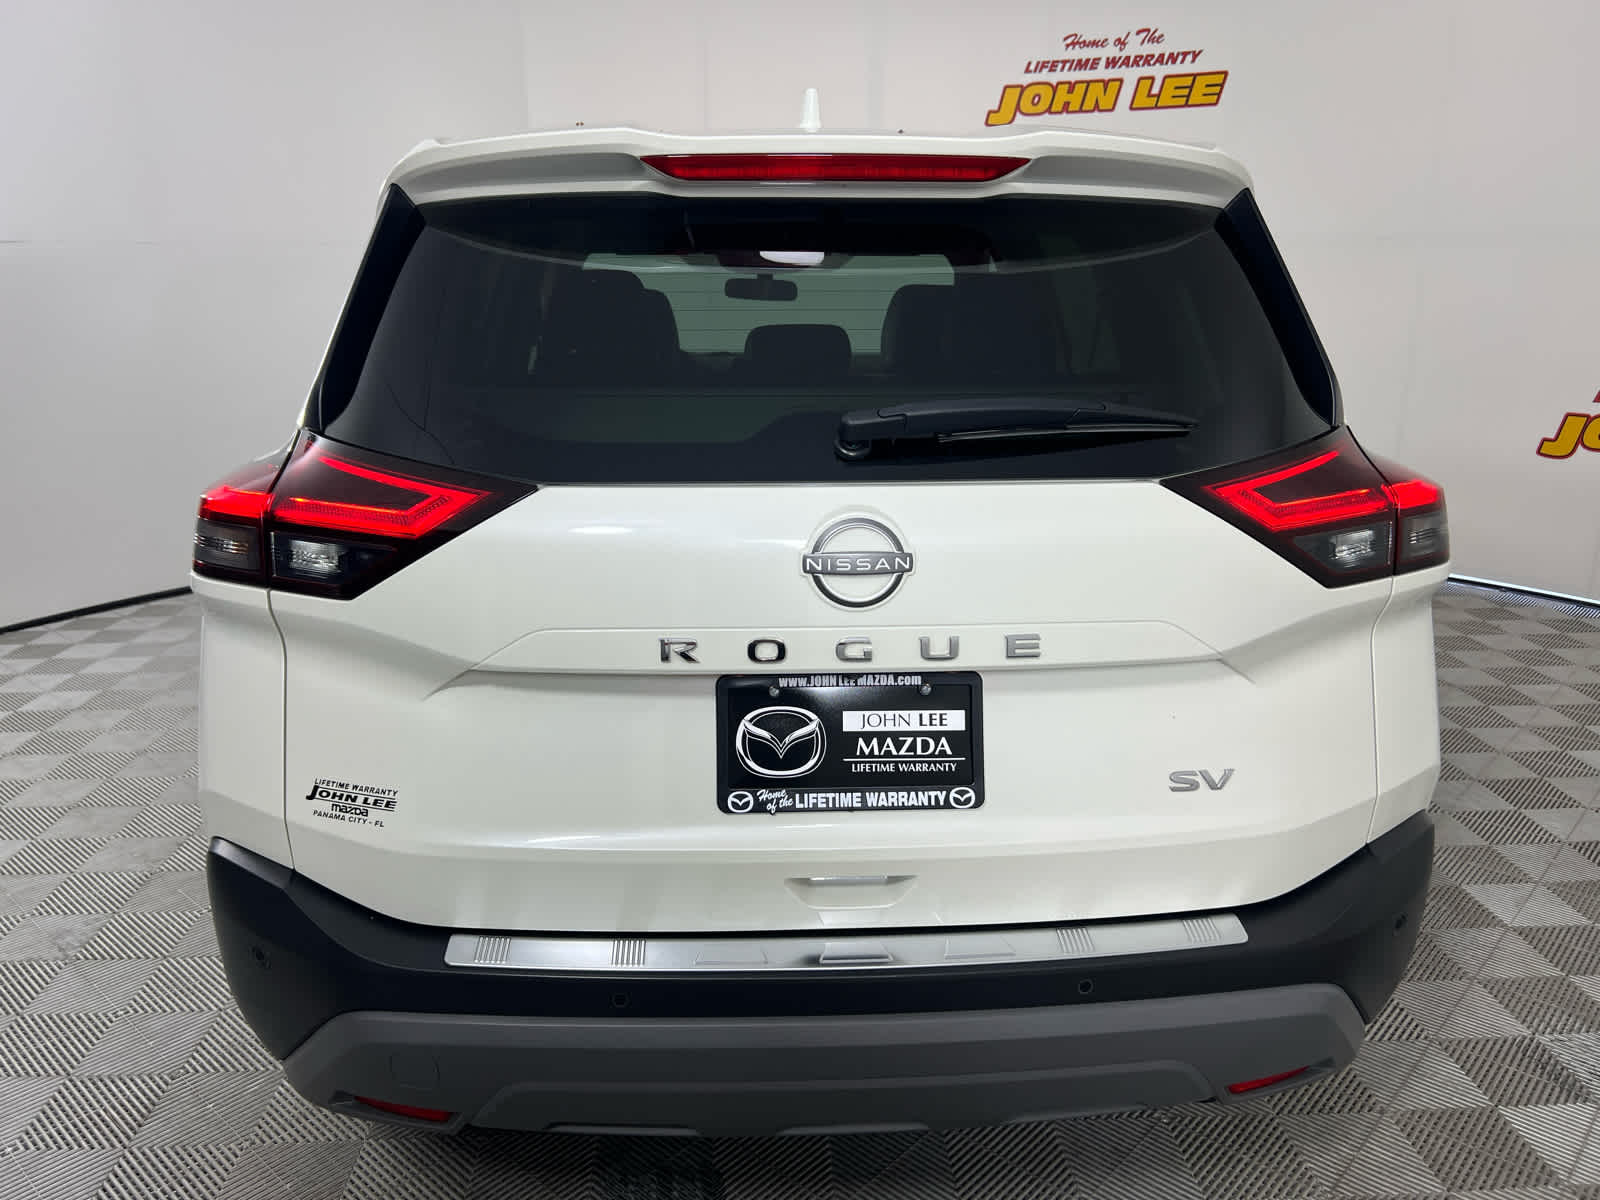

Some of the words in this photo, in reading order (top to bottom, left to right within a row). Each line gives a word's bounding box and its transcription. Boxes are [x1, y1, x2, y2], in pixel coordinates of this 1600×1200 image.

[1063, 33, 1109, 51] Home
[1113, 32, 1131, 51] of
[1135, 27, 1165, 45] The
[1024, 57, 1100, 74] LIFETIME
[1104, 49, 1204, 70] WARRANTY
[985, 78, 1124, 127] JOHN
[1129, 70, 1228, 111] LEE
[805, 556, 912, 572] NISSAN
[659, 633, 1042, 664] ROGUE
[860, 713, 911, 729] JOHN
[919, 713, 948, 727] LEE
[856, 736, 953, 756] MAZDA
[851, 762, 896, 773] LIFETIME
[898, 761, 957, 773] WARRANTY
[314, 778, 350, 790] LIFETIME
[352, 784, 398, 797] WARRANTY
[1168, 768, 1234, 792] SV
[305, 785, 358, 803] JOHN
[362, 797, 397, 810] LEE
[757, 790, 786, 799] Home
[795, 793, 862, 809] LIFETIME
[865, 791, 946, 808] WARRANTY
[766, 803, 778, 813] of
[779, 798, 793, 808] the
[313, 810, 346, 821] PANAMA
[374, 820, 385, 828] FL
